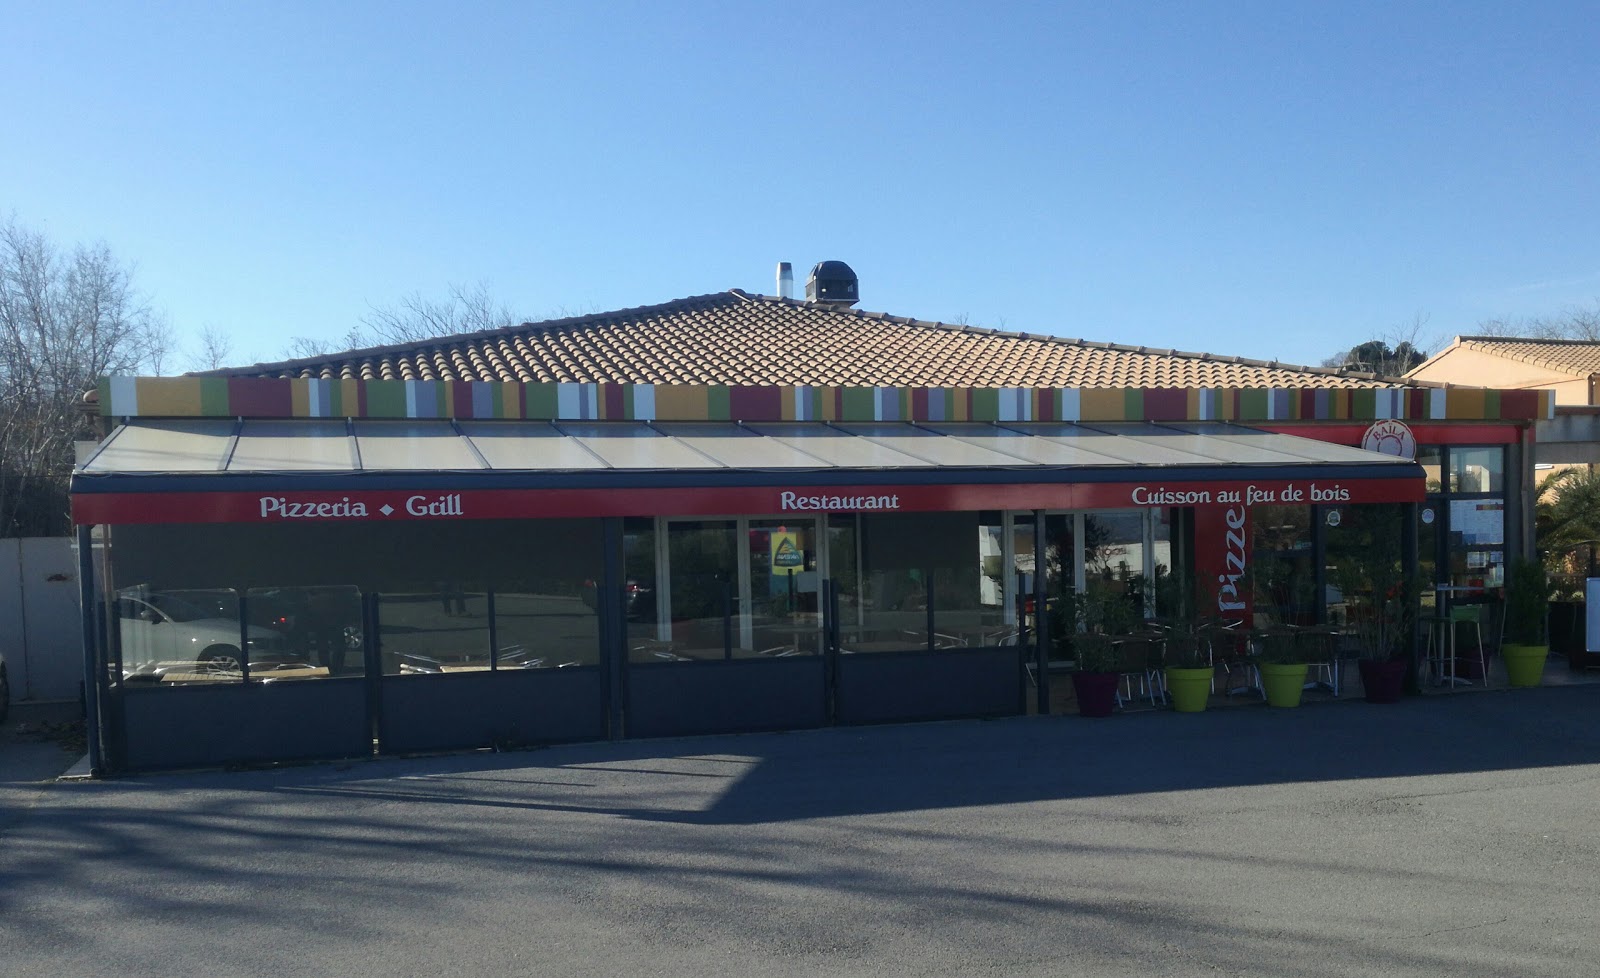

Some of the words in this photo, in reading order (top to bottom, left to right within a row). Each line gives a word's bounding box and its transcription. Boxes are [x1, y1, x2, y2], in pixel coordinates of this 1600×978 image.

[260, 496, 368, 518] Pizzeria
[406, 493, 464, 516] Grill
[780, 491, 900, 510] Restaurant
[1131, 486, 1211, 505] Cuisson
[1216, 490, 1241, 503] au
[1246, 485, 1276, 506] feu
[1280, 483, 1304, 502] de
[1310, 483, 1351, 502] bois
